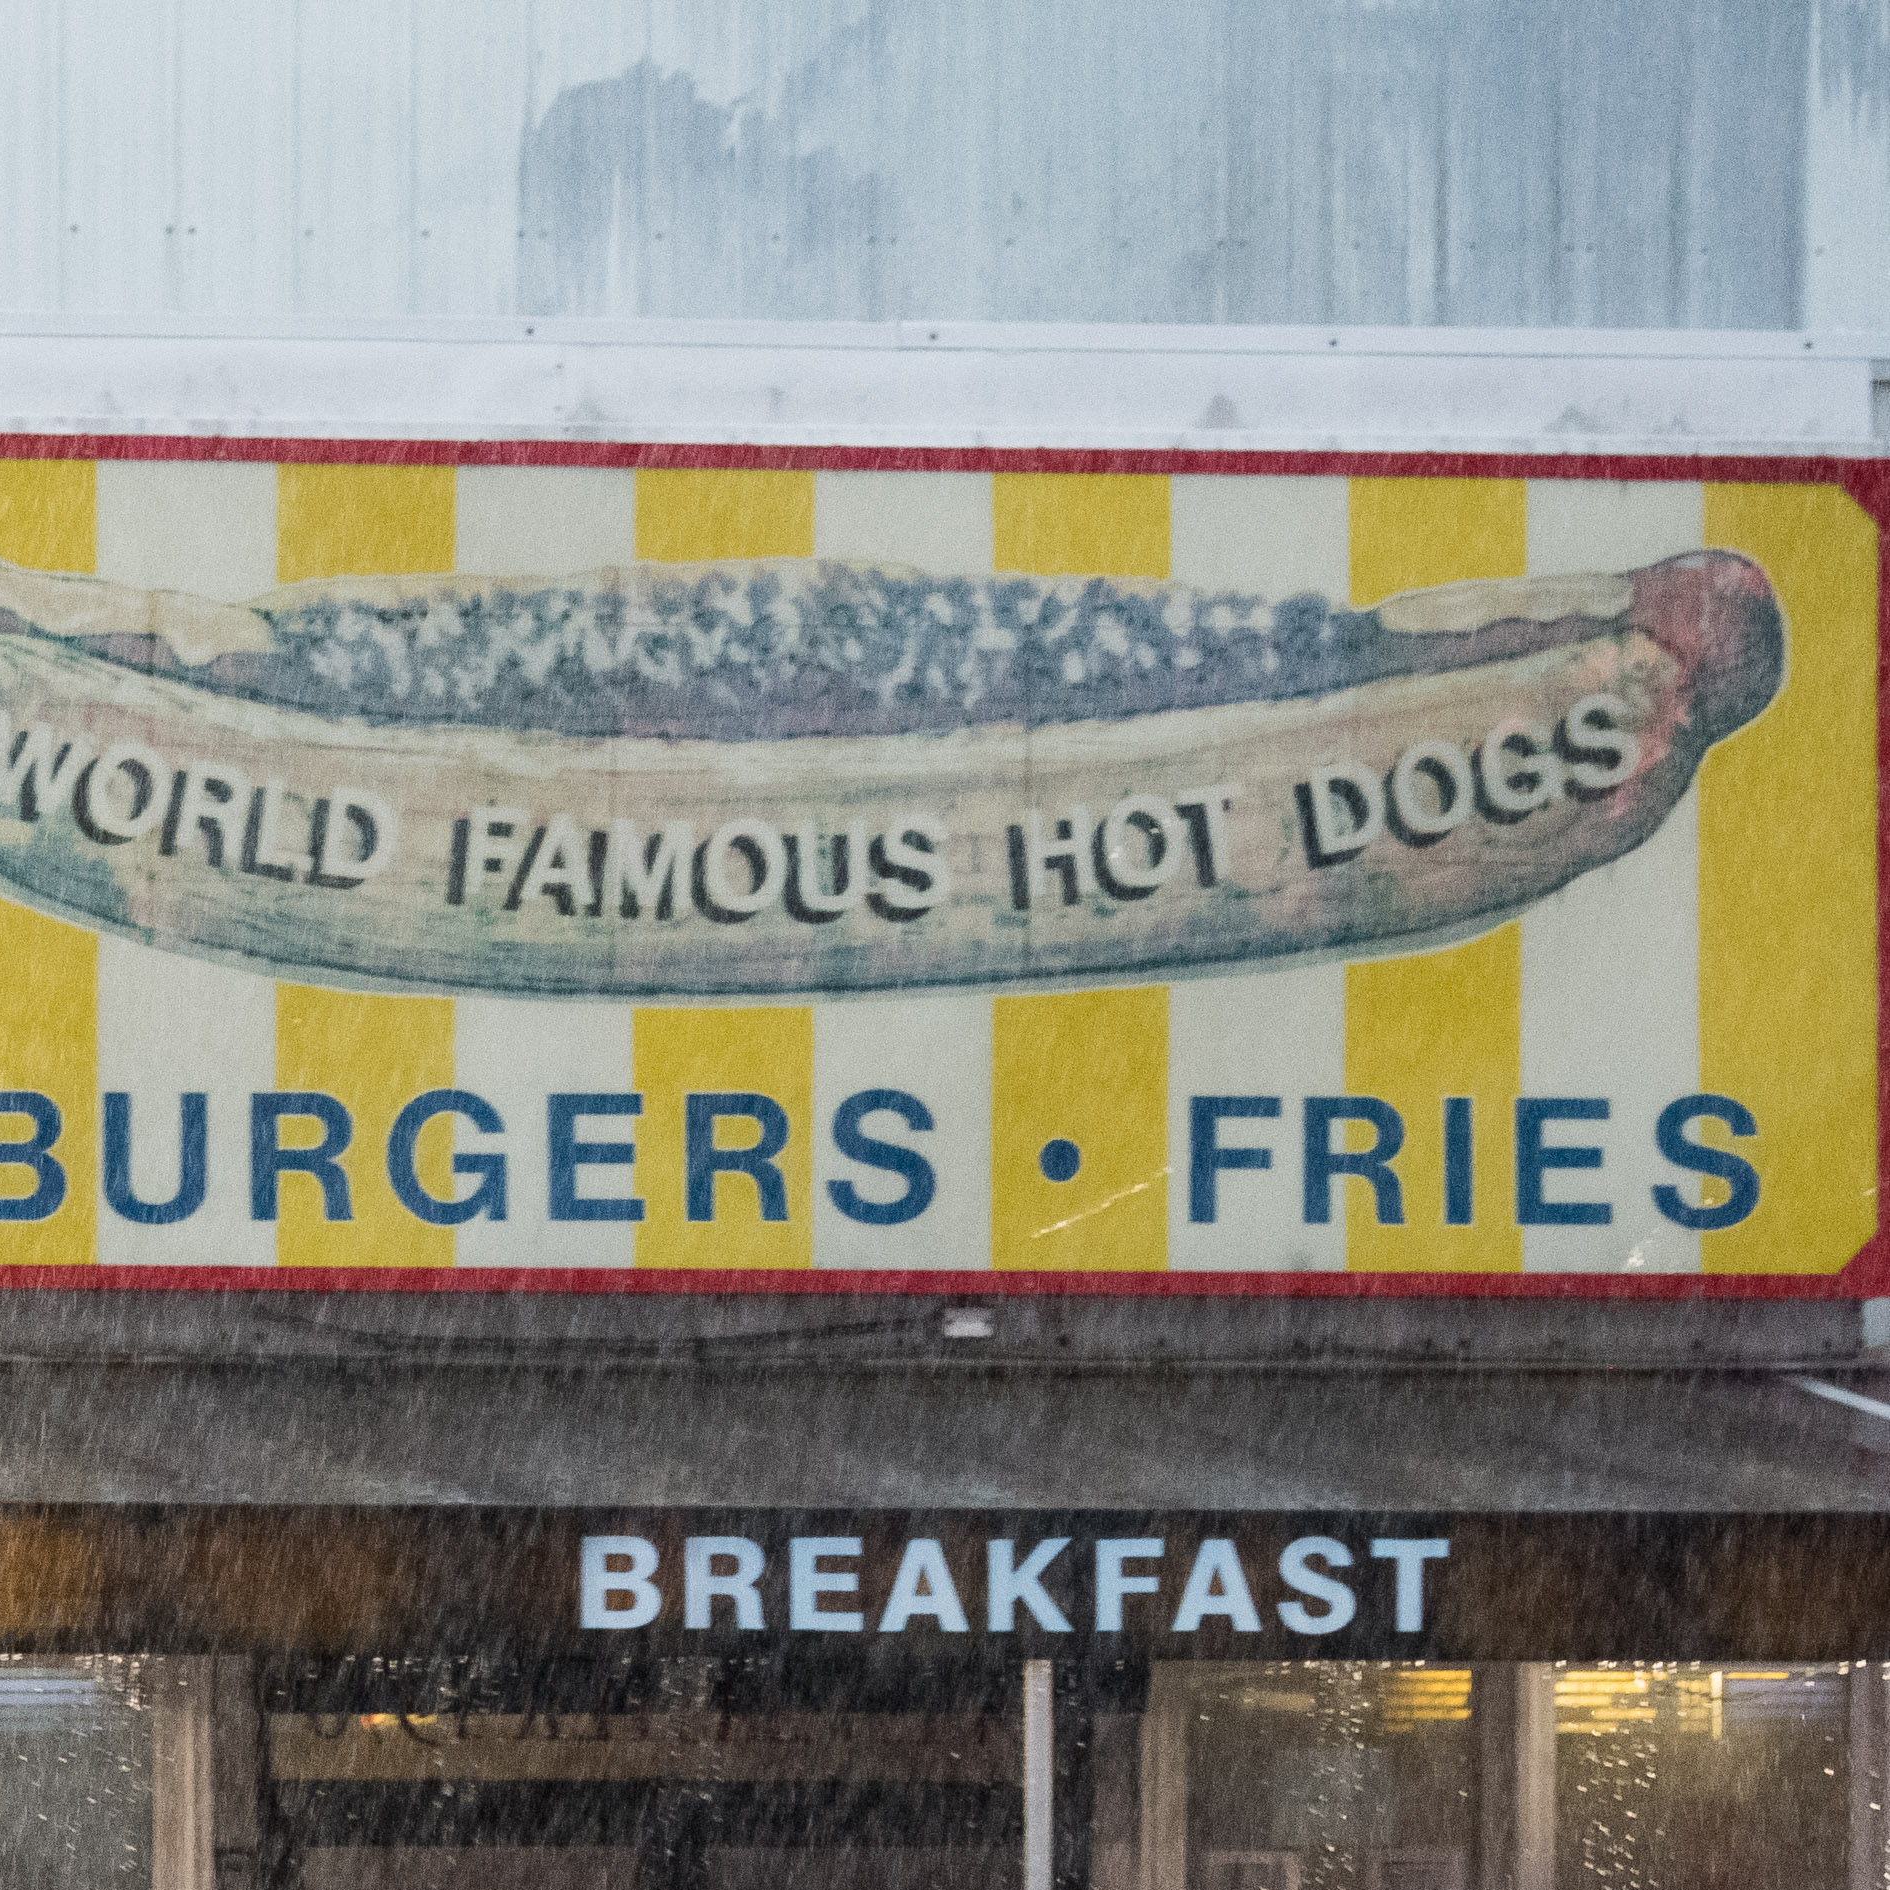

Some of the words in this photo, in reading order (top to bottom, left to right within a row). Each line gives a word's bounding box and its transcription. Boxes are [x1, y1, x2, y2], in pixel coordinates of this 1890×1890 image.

[443, 808, 946, 926] FAMOUS
[1006, 782, 1246, 911] HOT
[1291, 688, 1643, 868] DOGS
[1186, 1090, 1765, 1229] FRIES
[579, 1535, 1451, 1635] BREAKFAST
